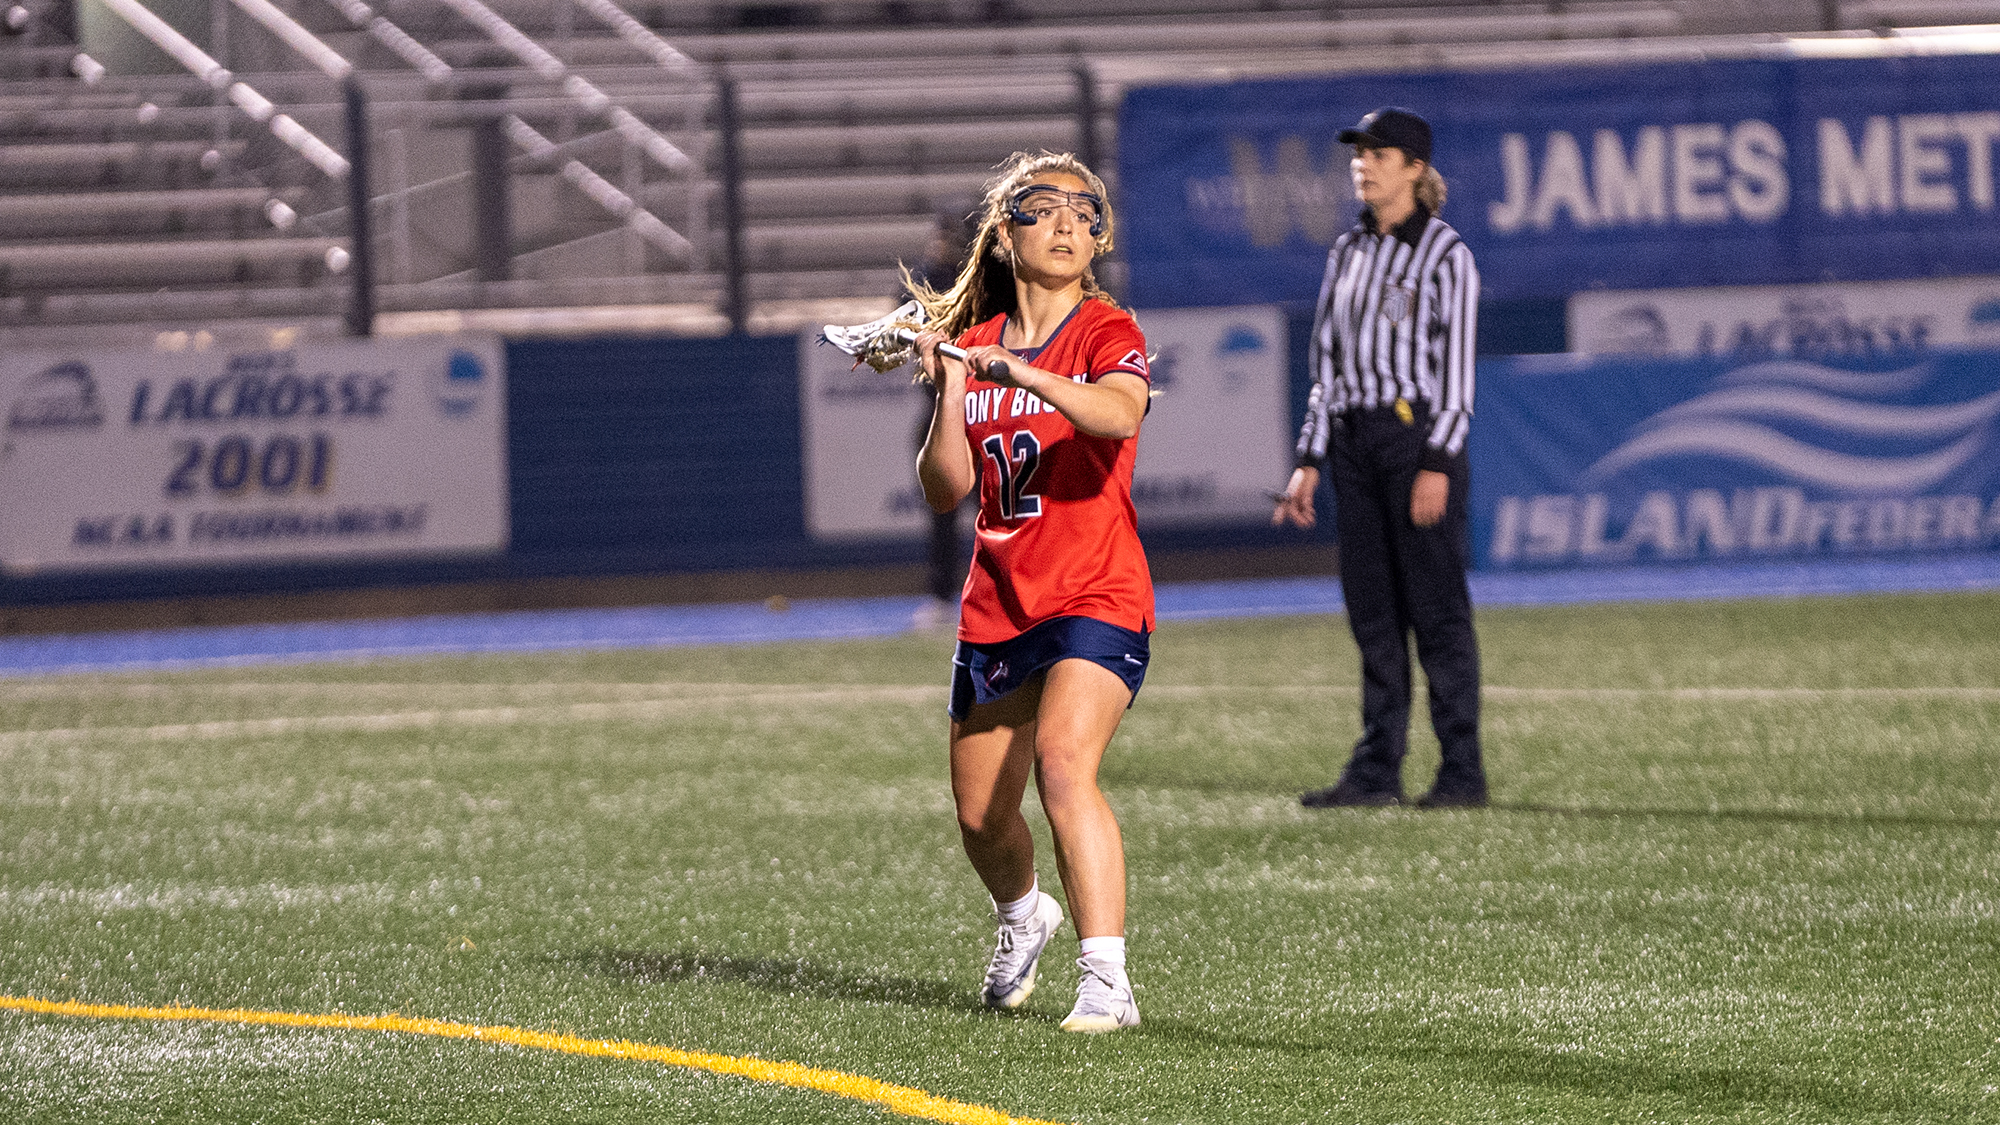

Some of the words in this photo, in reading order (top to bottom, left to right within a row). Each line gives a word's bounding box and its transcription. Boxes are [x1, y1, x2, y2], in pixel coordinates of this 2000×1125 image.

[1489, 119, 1788, 232] JAMES
[1816, 111, 2000, 217] MET
[129, 370, 396, 426] LACROSSE
[965, 386, 1008, 426] ONY
[164, 434, 334, 496] 2001
[982, 430, 1042, 520] 12
